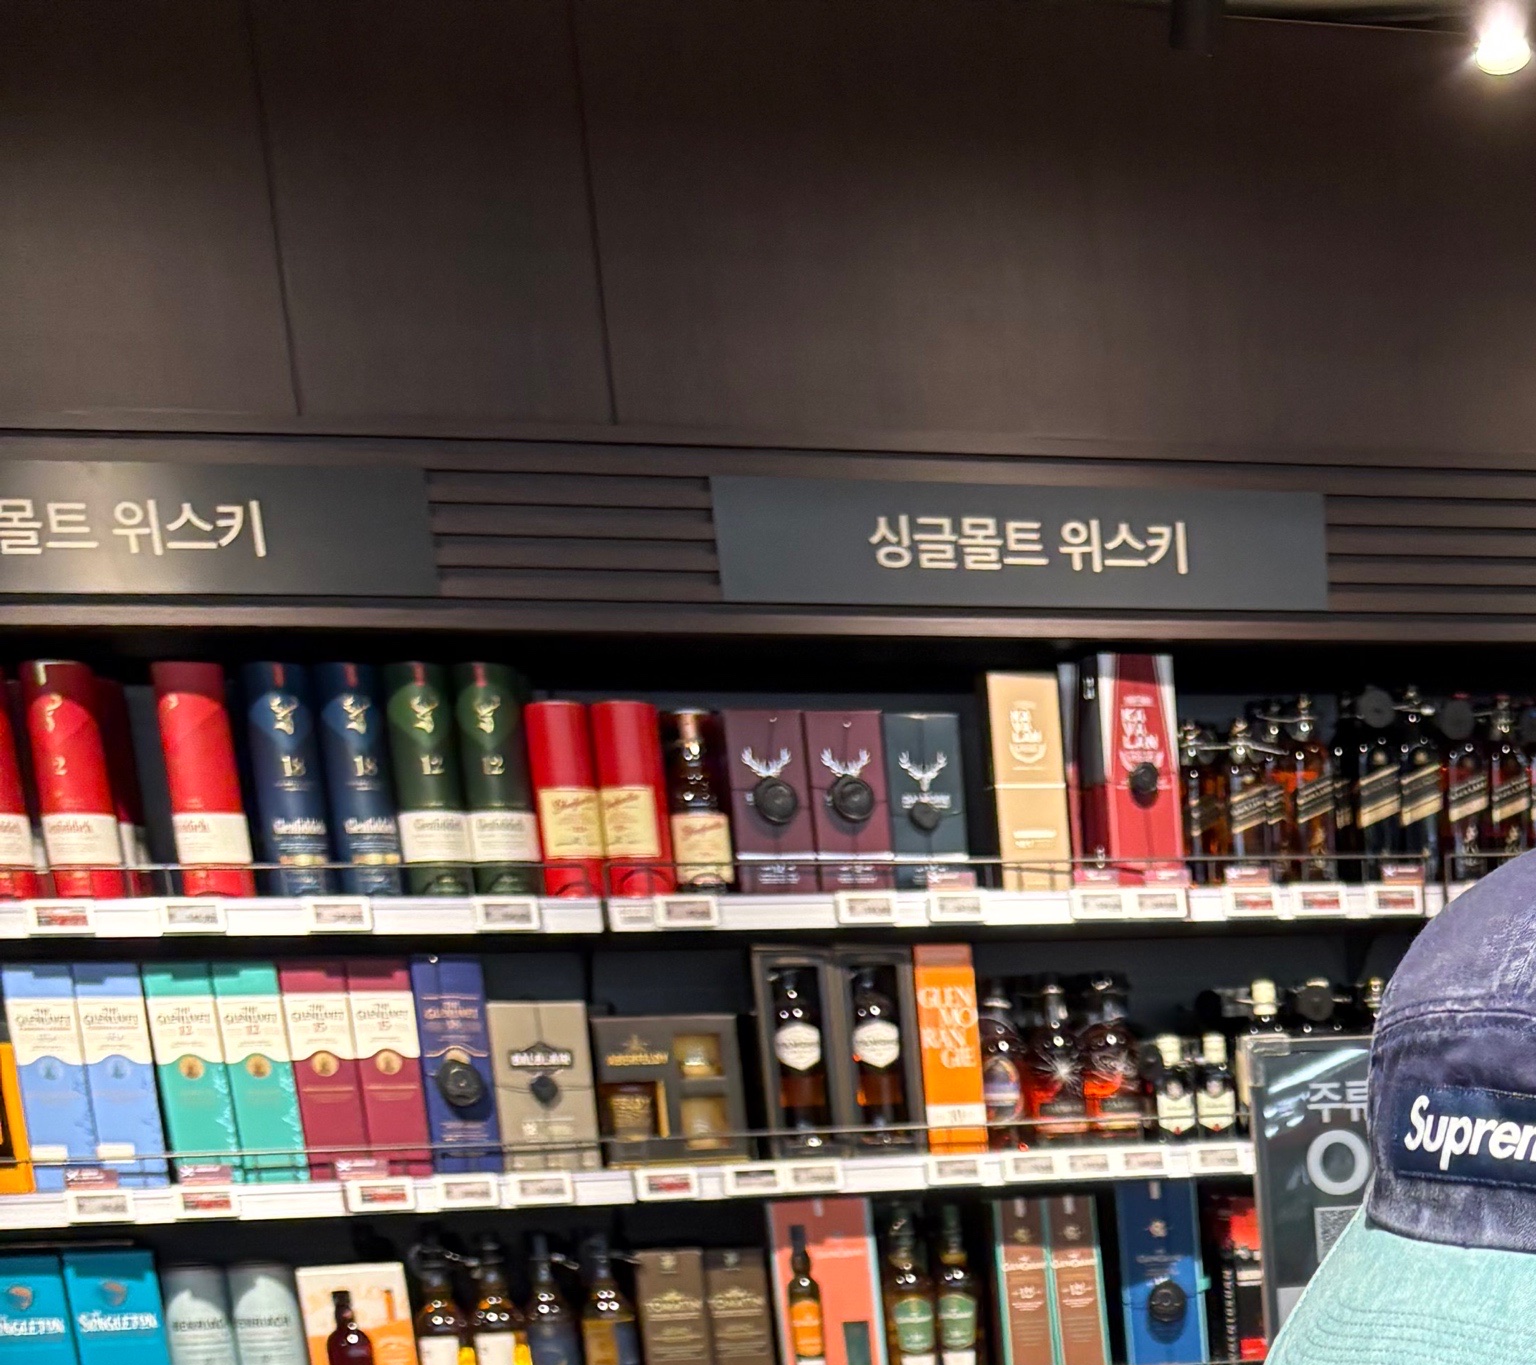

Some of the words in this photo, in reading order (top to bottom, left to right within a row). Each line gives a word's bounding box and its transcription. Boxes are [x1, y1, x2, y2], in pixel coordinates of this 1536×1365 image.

[112, 499, 267, 557] 위스키
[868, 513, 1049, 571] 싱글몰트
[1058, 519, 1189, 575] 위스키
